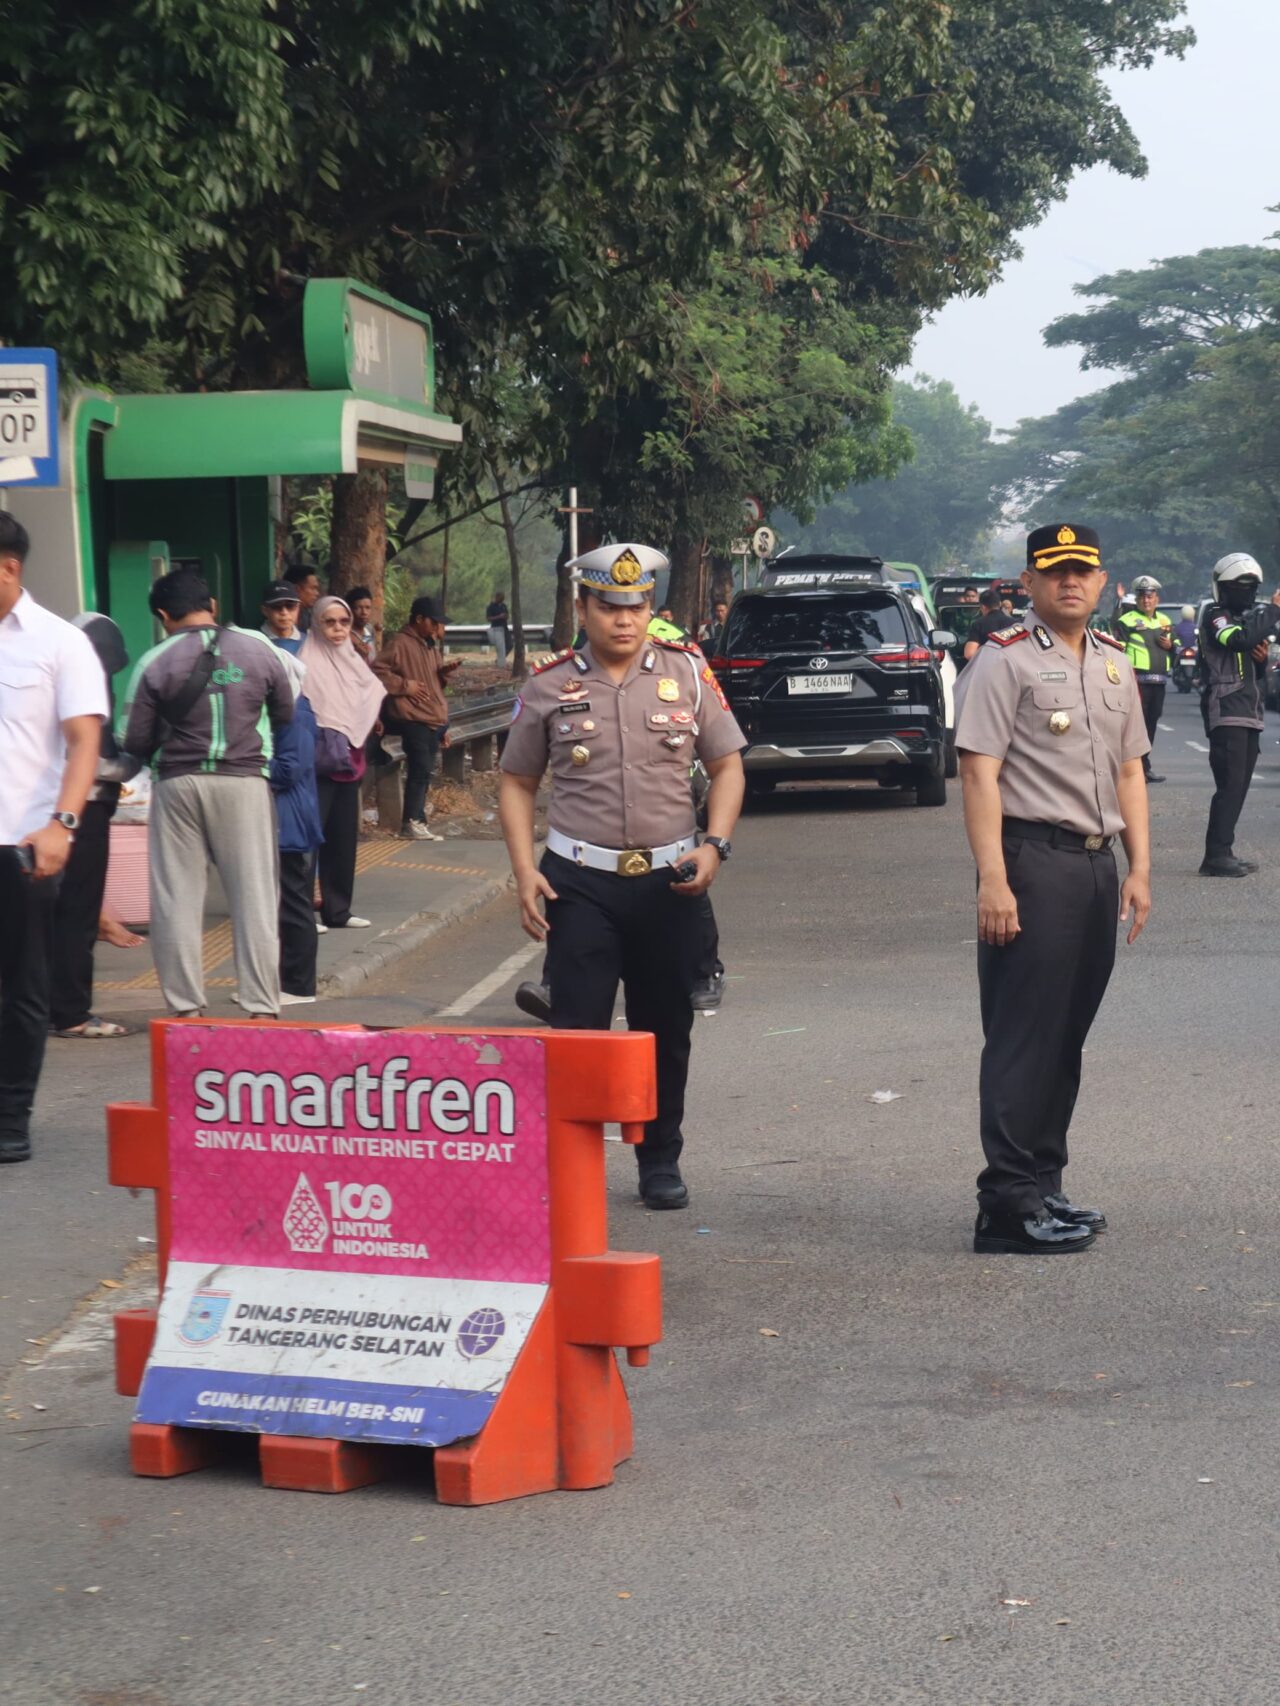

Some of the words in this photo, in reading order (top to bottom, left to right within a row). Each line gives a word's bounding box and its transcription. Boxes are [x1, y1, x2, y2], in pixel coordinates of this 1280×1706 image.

[790, 676, 797, 689] B
[804, 675, 830, 689] 1466
[830, 673, 850, 688] NAA
[194, 1056, 516, 1136] smartfren
[195, 1129, 267, 1152] SINYAL
[271, 1133, 328, 1155] KUAT
[332, 1136, 439, 1160] INTERNET
[441, 1141, 516, 1163] CEPAT
[332, 1220, 393, 1239] UNTUK
[333, 1239, 430, 1260] INDONESIA
[235, 1303, 298, 1324] DINAS
[298, 1307, 452, 1334] PERHUBUNGAN
[227, 1326, 347, 1350] TANGERANG
[349, 1335, 445, 1358] SELATAN
[197, 1390, 291, 1413] GUNAKAN
[291, 1396, 345, 1417] HELM
[345, 1401, 426, 1424] BER-SNI
